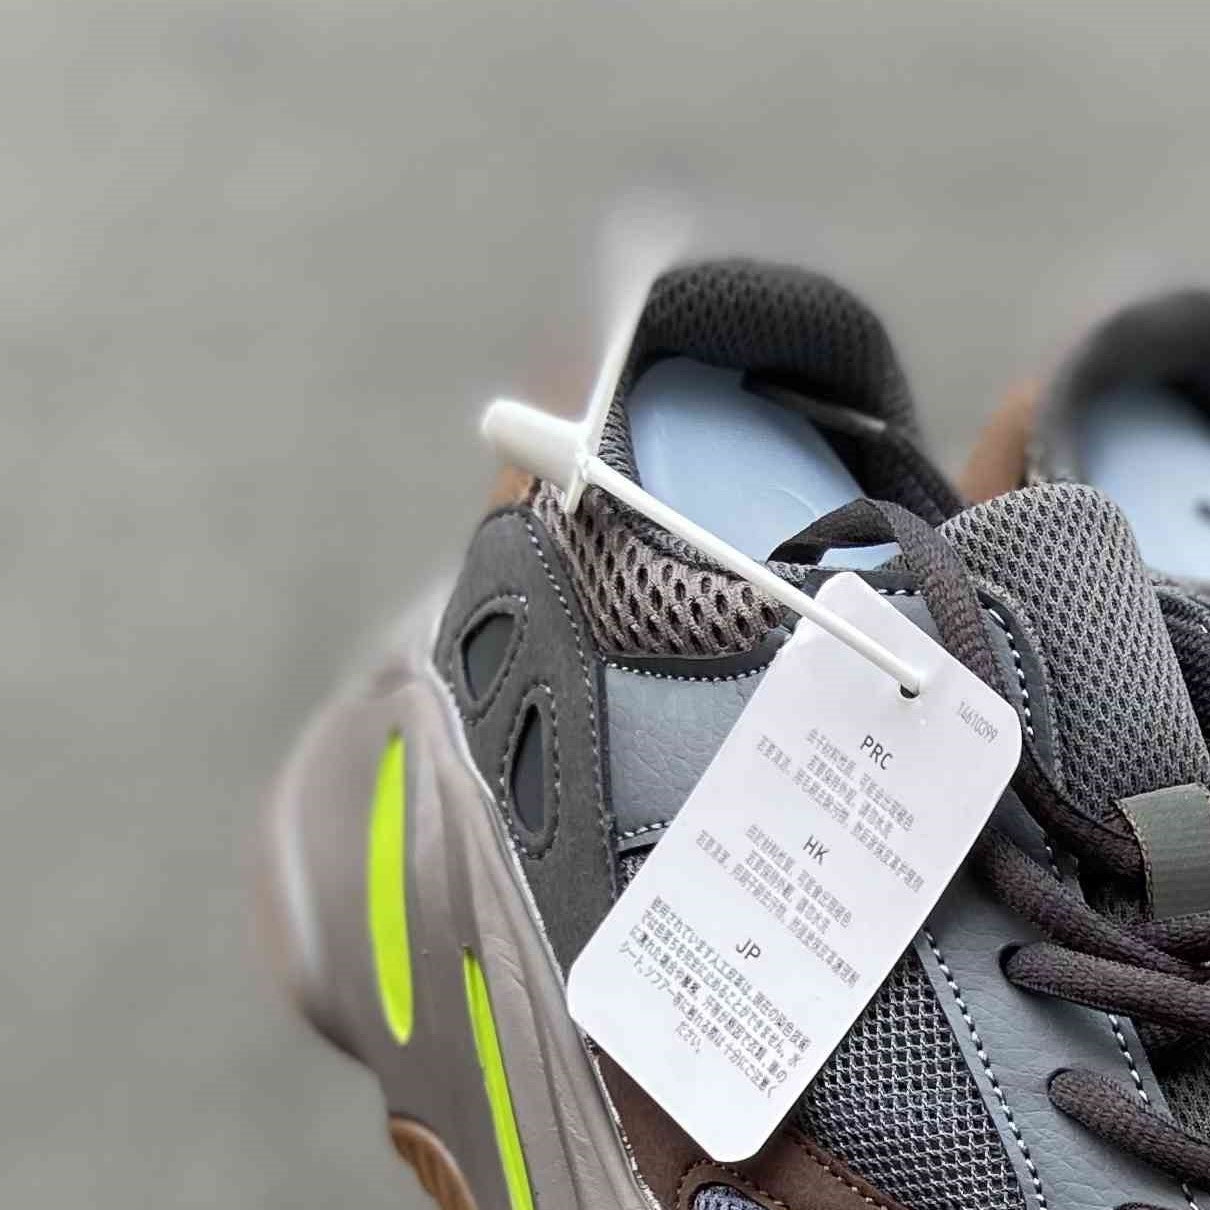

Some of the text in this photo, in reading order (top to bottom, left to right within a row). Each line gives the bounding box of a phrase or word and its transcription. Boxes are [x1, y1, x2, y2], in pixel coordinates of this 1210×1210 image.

[858, 732, 894, 771] PRC
[800, 833, 831, 867] HK
[732, 933, 764, 968] JP
